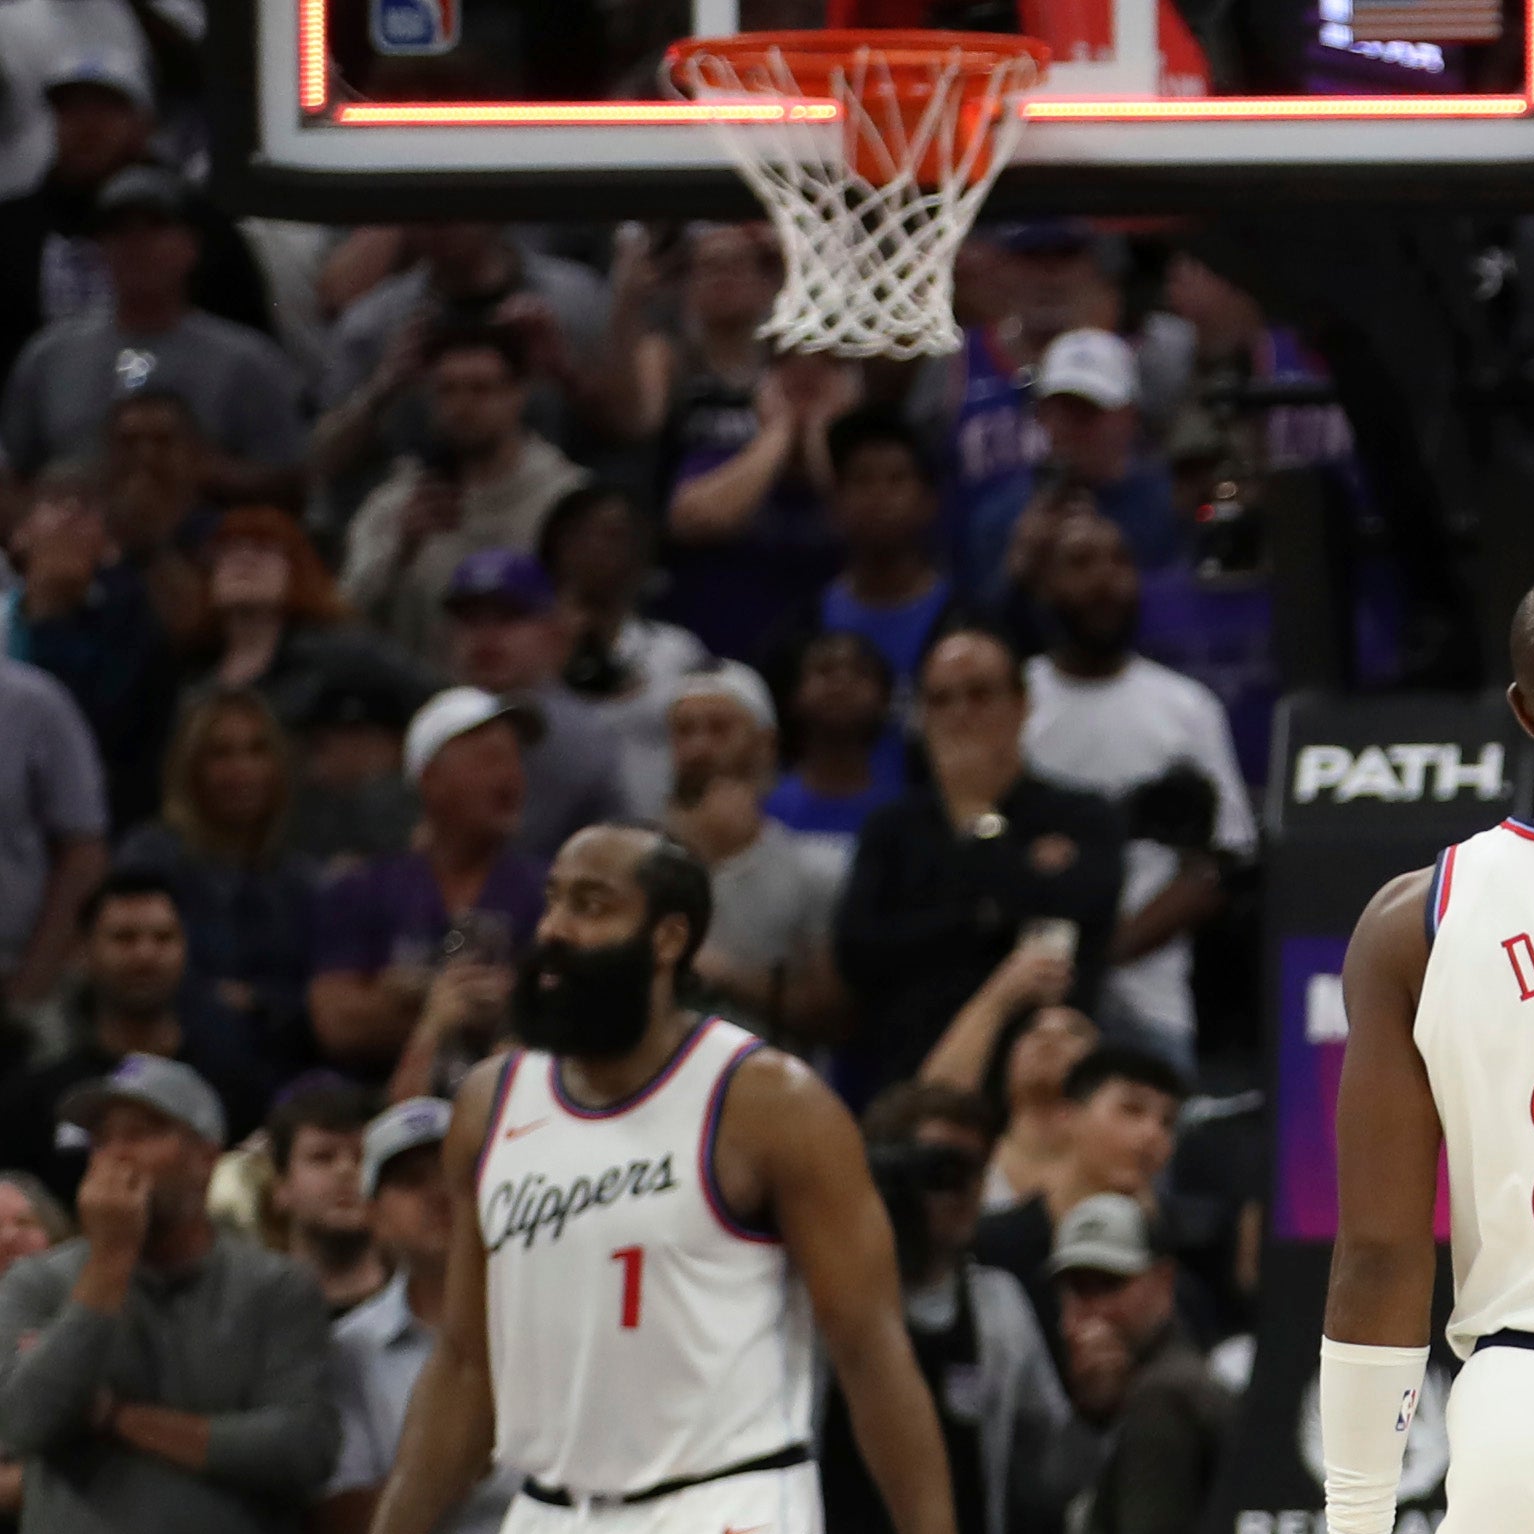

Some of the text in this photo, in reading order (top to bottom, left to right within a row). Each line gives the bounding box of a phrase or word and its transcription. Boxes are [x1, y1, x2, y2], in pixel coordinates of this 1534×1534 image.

[1295, 742, 1505, 804] PATH
[484, 1152, 680, 1254] Clippers
[609, 1243, 645, 1330] 1
